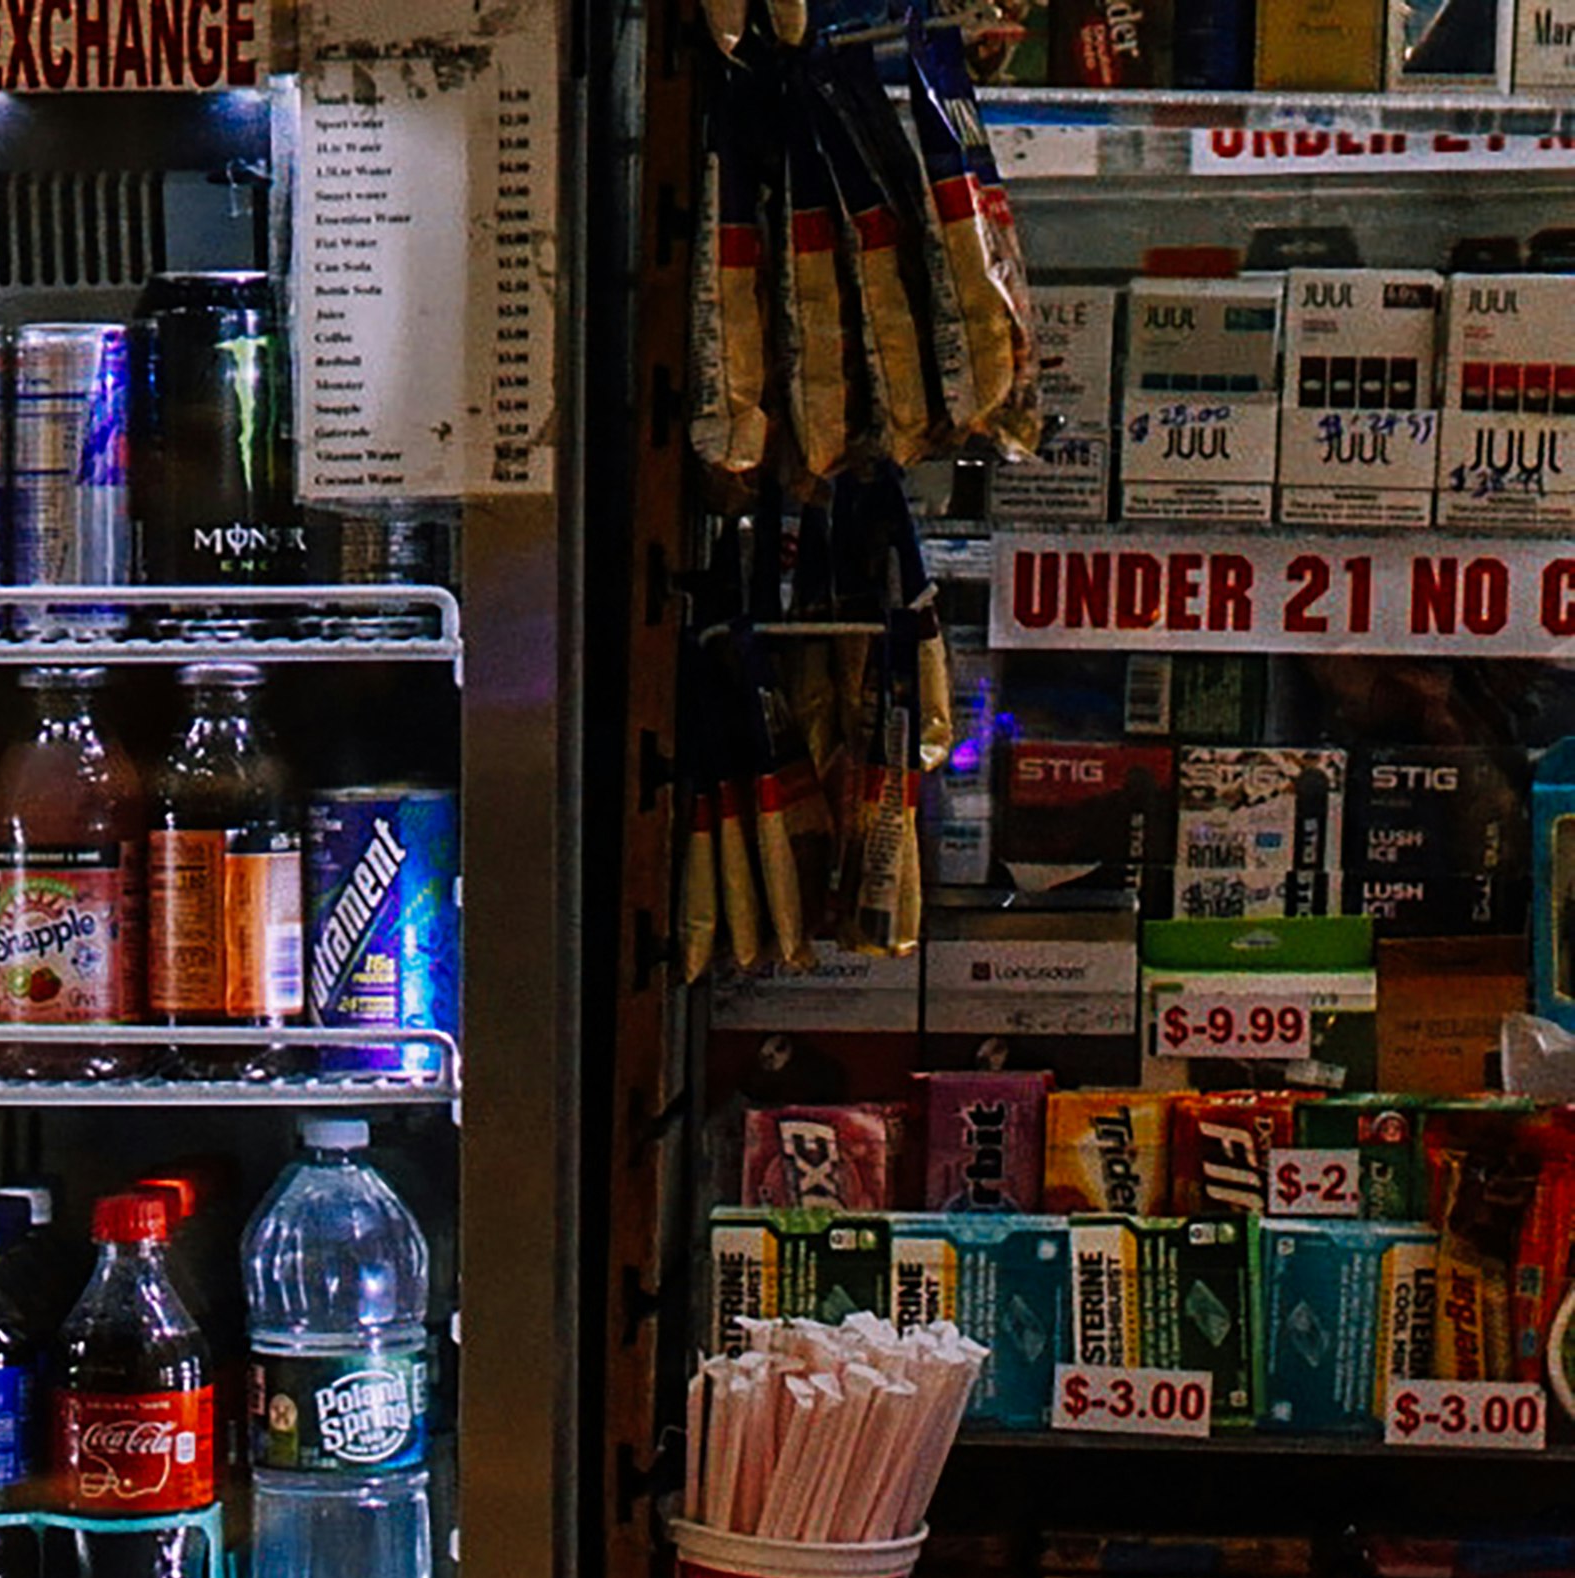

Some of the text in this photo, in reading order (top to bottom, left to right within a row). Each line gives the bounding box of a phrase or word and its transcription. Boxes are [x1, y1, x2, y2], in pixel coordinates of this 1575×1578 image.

[315, 261, 372, 273] Can Soda
[315, 285, 383, 297] Bottle Soda
[1301, 284, 1353, 309] JUUL
[1468, 289, 1519, 315] JUUL
[316, 309, 346, 321] Juice
[1144, 305, 1196, 330] JUUL
[315, 332, 353, 344] Coffee
[1163, 427, 1230, 459] JUUL
[1322, 433, 1391, 465] JUUL
[1469, 429, 1561, 473] JUUL
[367, 473, 405, 485] Water
[1013, 551, 1253, 630] UNDER
[1284, 555, 1371, 633] 21
[1411, 556, 1510, 635] NO
[1017, 757, 1106, 784] STIG
[1370, 763, 1460, 791] STIG
[1367, 826, 1427, 848] LUSH
[1366, 846, 1399, 863] ICE
[1362, 879, 1426, 901] LUSH
[1164, 1005, 1304, 1048] $-9.99
[966, 1100, 1004, 1204] rbit
[1393, 1284, 1410, 1335] COOL
[1447, 1262, 1482, 1381] owerBar
[316, 1377, 408, 1421] Poland
[1063, 1375, 1207, 1421] $-3.00
[319, 1402, 412, 1452] Spring
[1395, 1391, 1540, 1437] $-3.00
